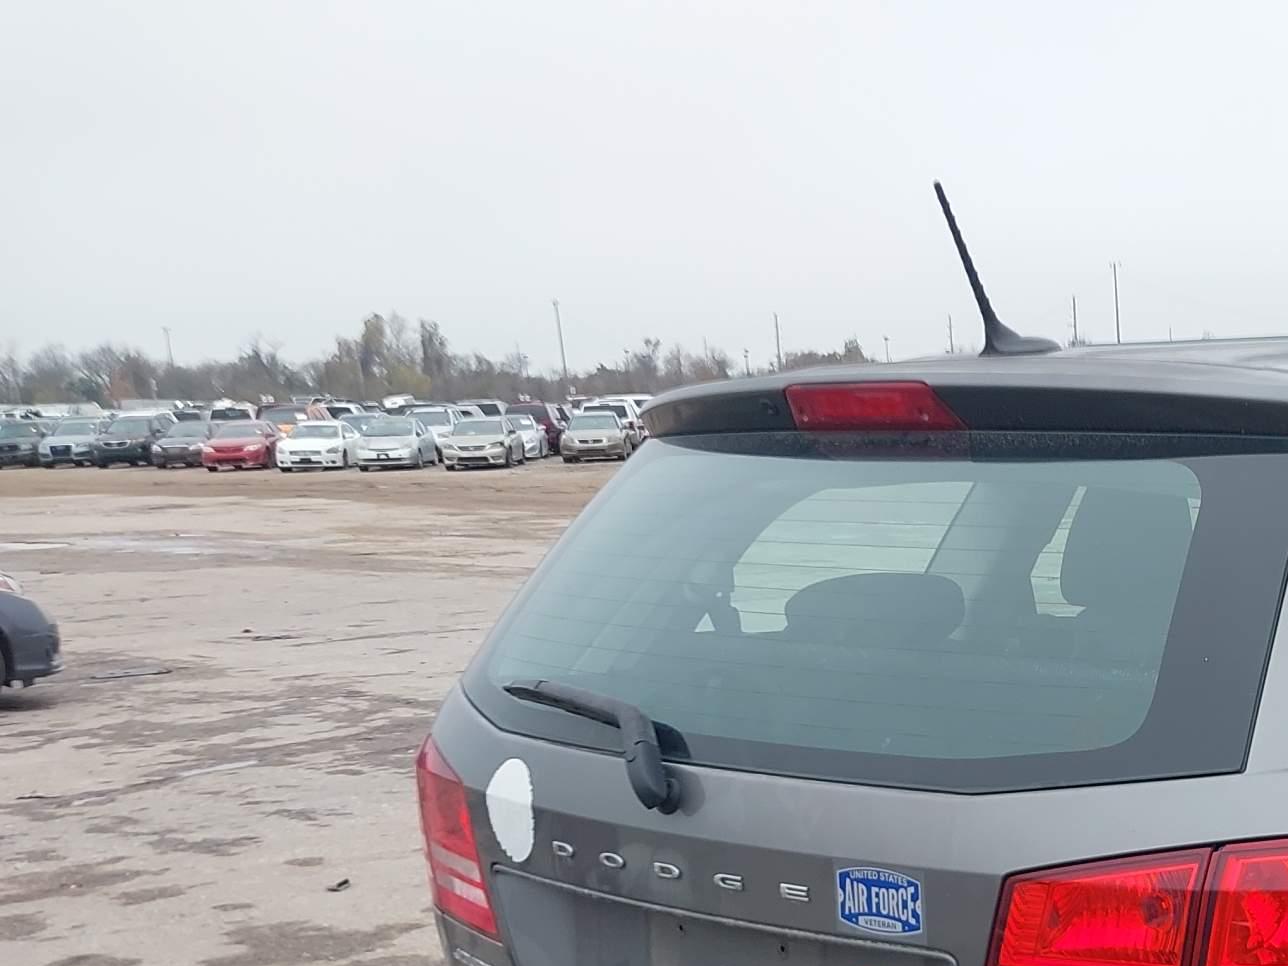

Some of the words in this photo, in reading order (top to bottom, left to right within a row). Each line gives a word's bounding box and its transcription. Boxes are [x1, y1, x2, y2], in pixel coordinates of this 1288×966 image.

[552, 840, 809, 902] DODGE
[849, 870, 878, 880] UNITED
[879, 873, 908, 887] STATES
[845, 877, 869, 915] AIR
[871, 886, 917, 926] FORCE
[863, 918, 898, 930] VETERAN
